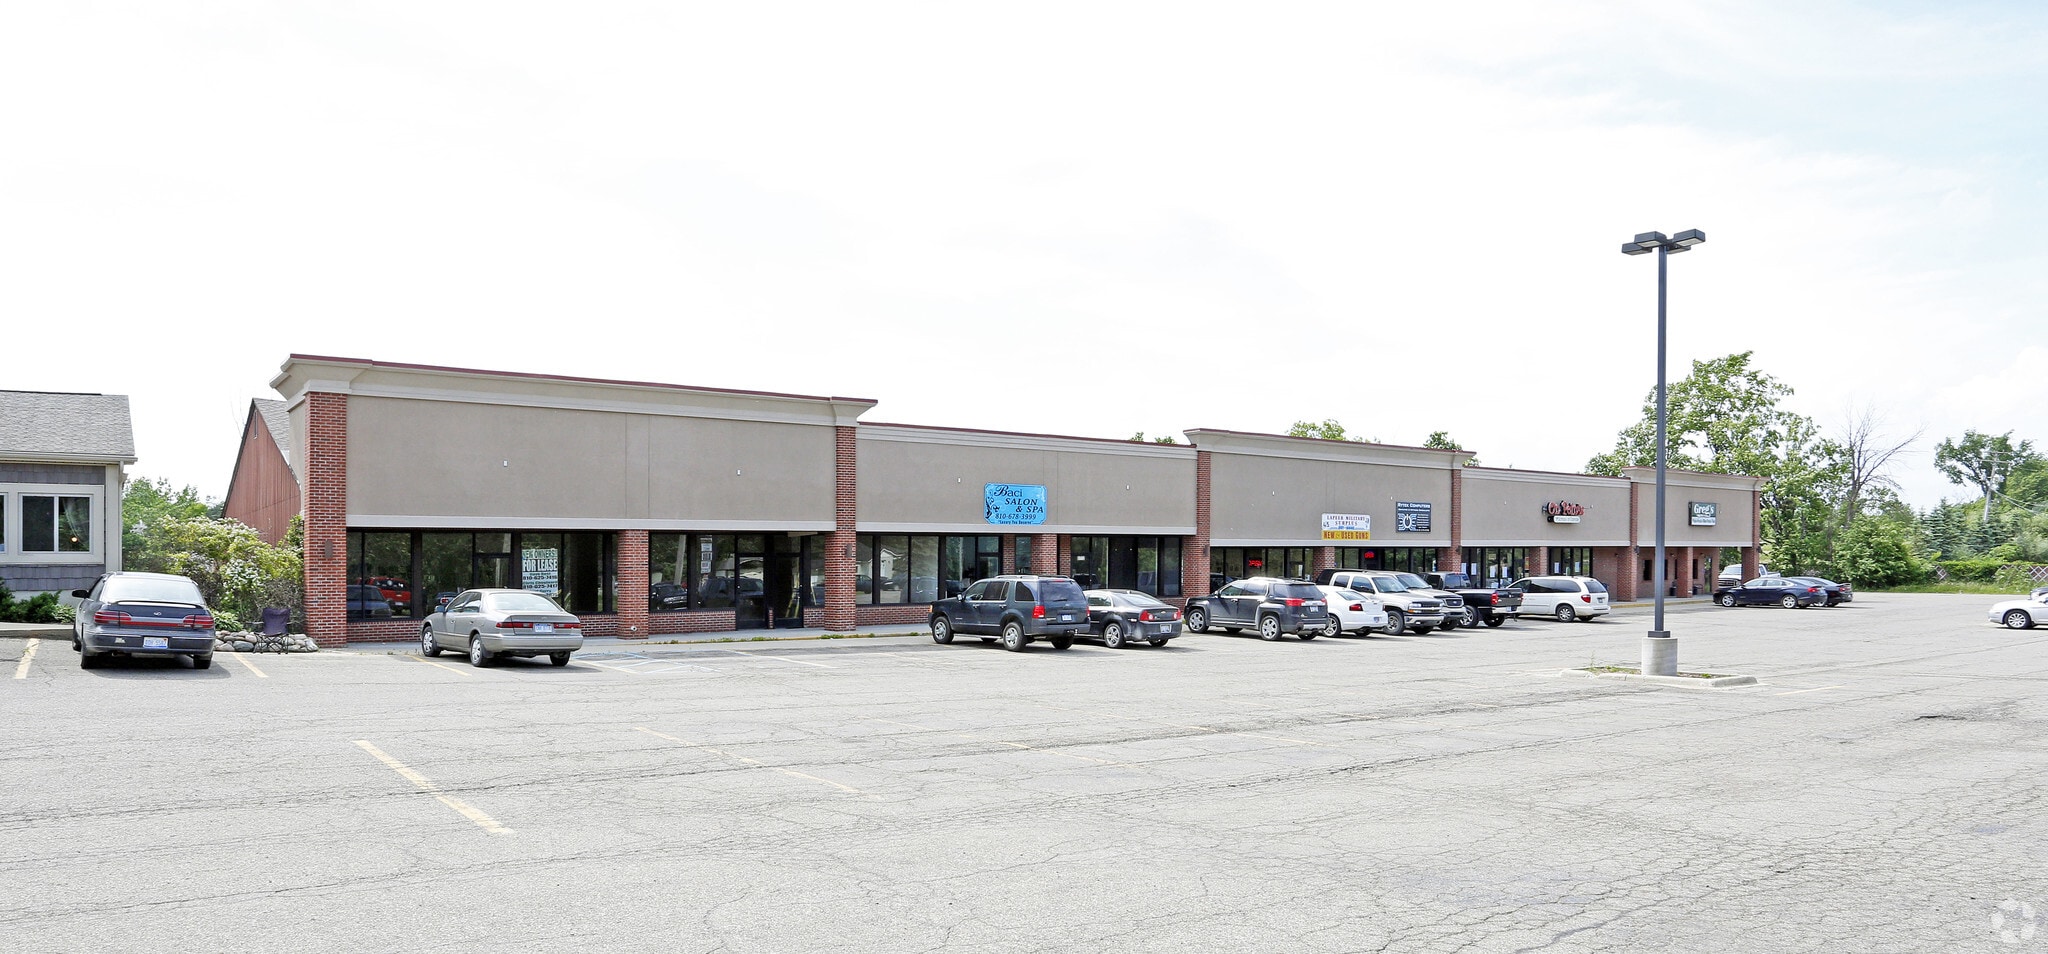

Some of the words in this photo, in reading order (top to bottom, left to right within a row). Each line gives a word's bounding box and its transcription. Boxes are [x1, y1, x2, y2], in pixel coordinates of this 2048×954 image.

[994, 485, 1022, 497] Baci
[1004, 498, 1038, 506] SALON
[1026, 505, 1044, 514] SPA
[1694, 503, 1714, 517] Greg's
[1323, 531, 1335, 539] NEW
[1341, 531, 1353, 539] USED
[1356, 531, 1368, 539] GUNS
[523, 559, 536, 571] FOR
[538, 559, 558, 571] LEASE
